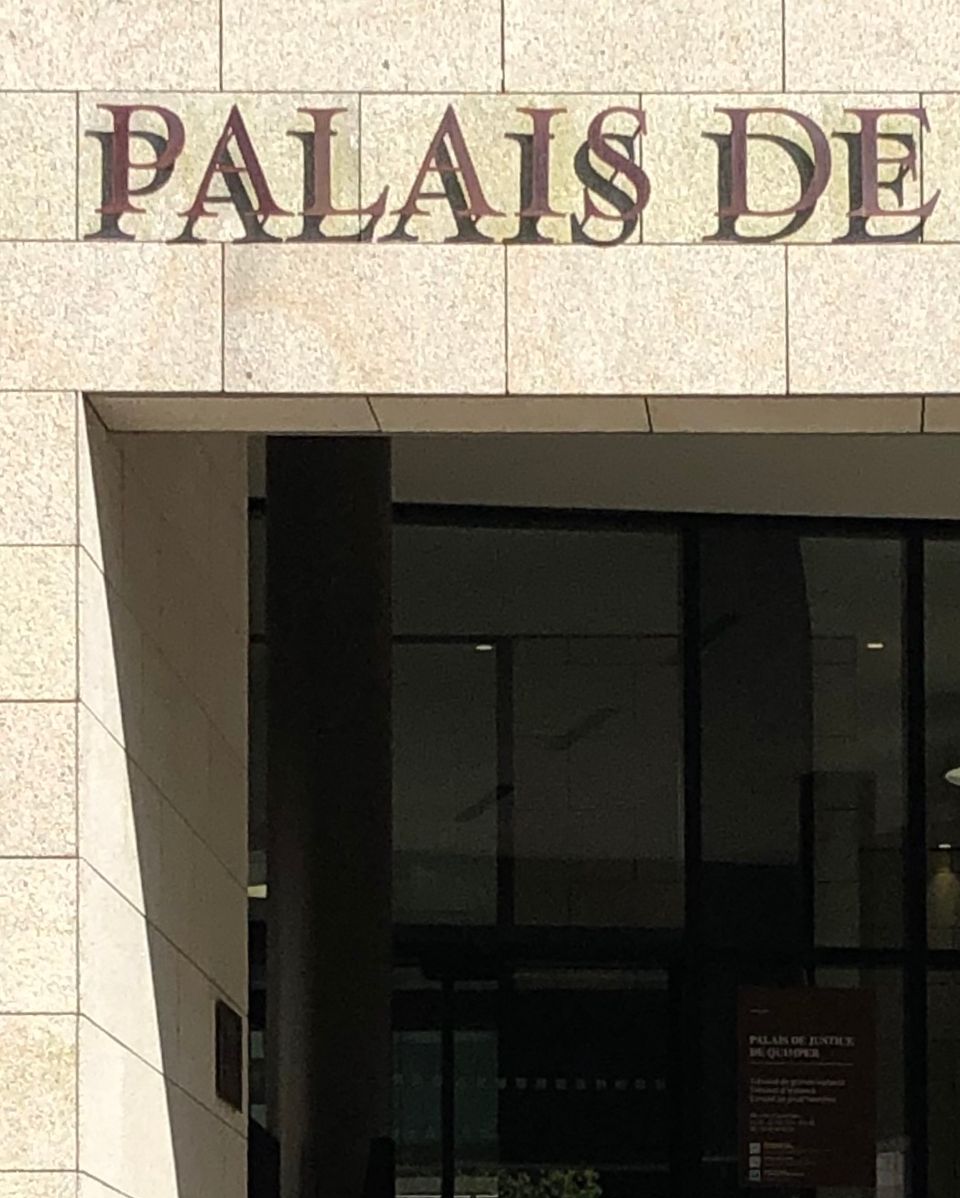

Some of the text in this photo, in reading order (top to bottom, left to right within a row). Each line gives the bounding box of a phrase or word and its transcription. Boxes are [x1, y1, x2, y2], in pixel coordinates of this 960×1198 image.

[95, 104, 653, 221] PALAIS
[712, 106, 942, 218] DE
[748, 1035, 856, 1048] PALAIS DE JUSTICE
